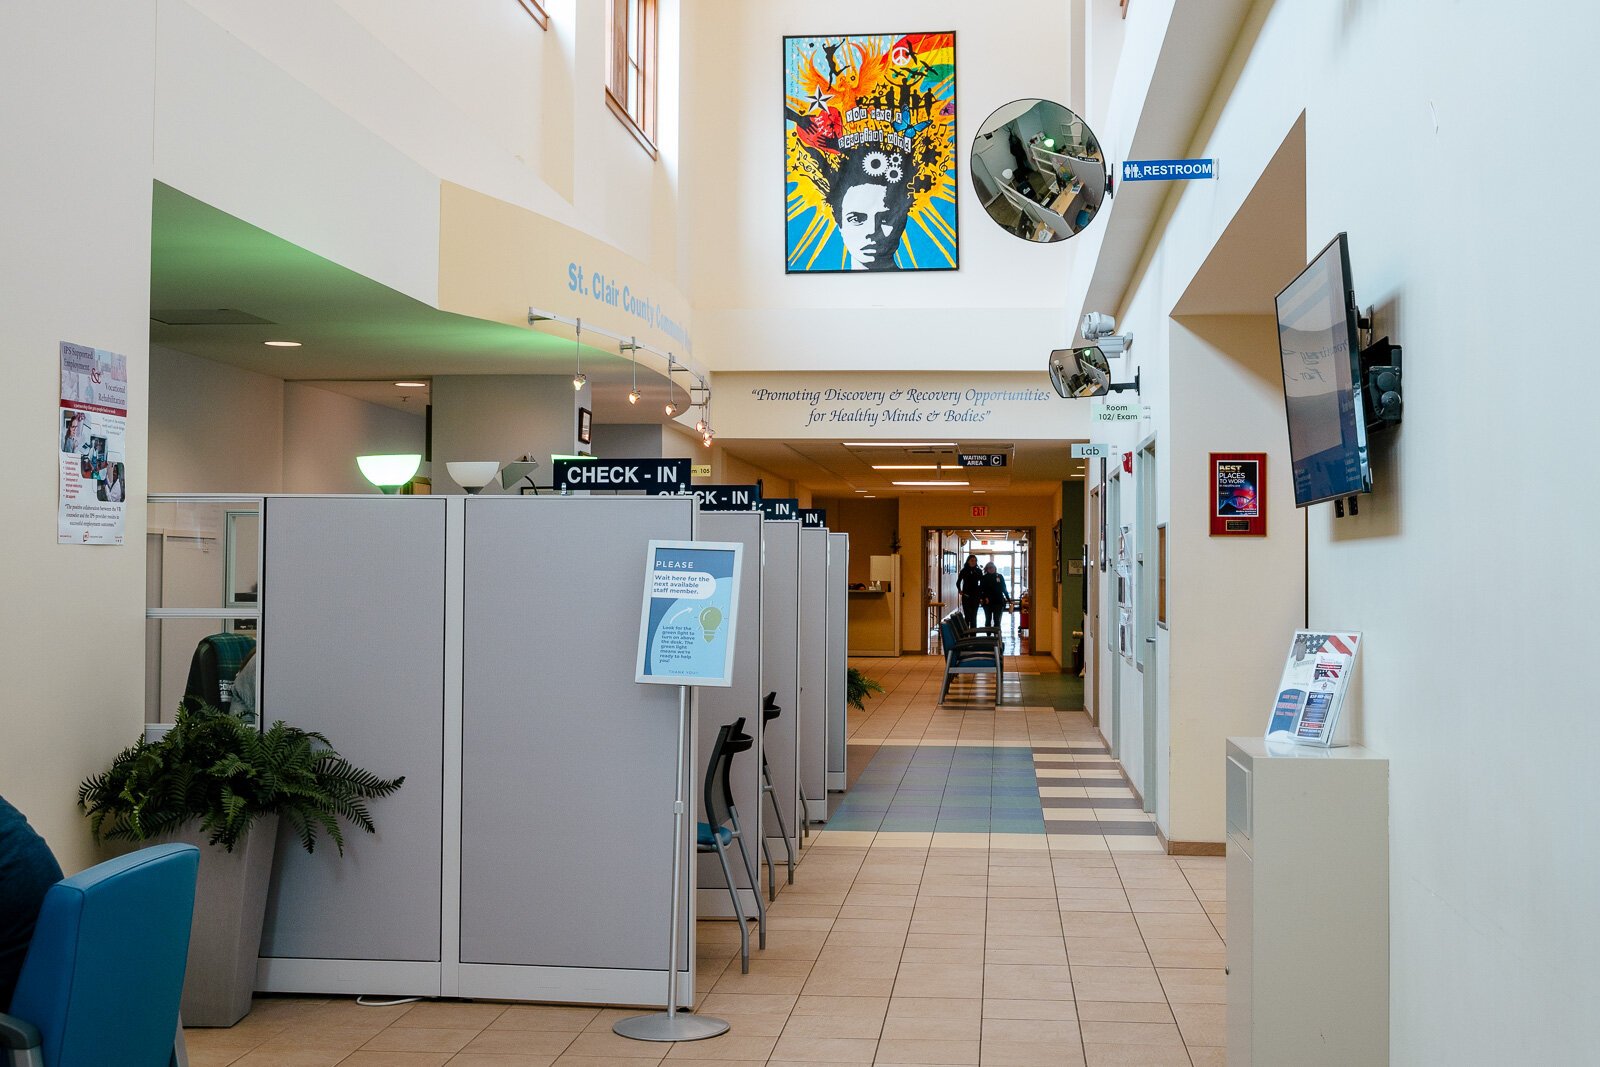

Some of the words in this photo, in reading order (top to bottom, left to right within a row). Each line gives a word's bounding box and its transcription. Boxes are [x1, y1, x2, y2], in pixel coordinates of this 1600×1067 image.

[1144, 164, 1212, 176] RESTROOM
[568, 262, 588, 295] St.
[592, 272, 619, 307] Clair
[623, 286, 654, 328] County
[91, 368, 101, 384] &
[824, 388, 885, 406] Discovery
[889, 389, 903, 400] &
[907, 388, 961, 406] Recovery
[965, 388, 1050, 406] Opportunities
[805, 408, 826, 427] for
[829, 408, 879, 427] Healthy
[882, 408, 922, 422] Minds
[926, 410, 941, 422] &
[1081, 446, 1100, 456] Lab
[567, 466, 639, 483] CHECK
[657, 466, 676, 482] IN
[732, 491, 748, 504] IN
[776, 504, 790, 514] IN
[973, 506, 985, 516] EXIT
[806, 514, 818, 523] IN
[656, 560, 694, 568] PLEASE
